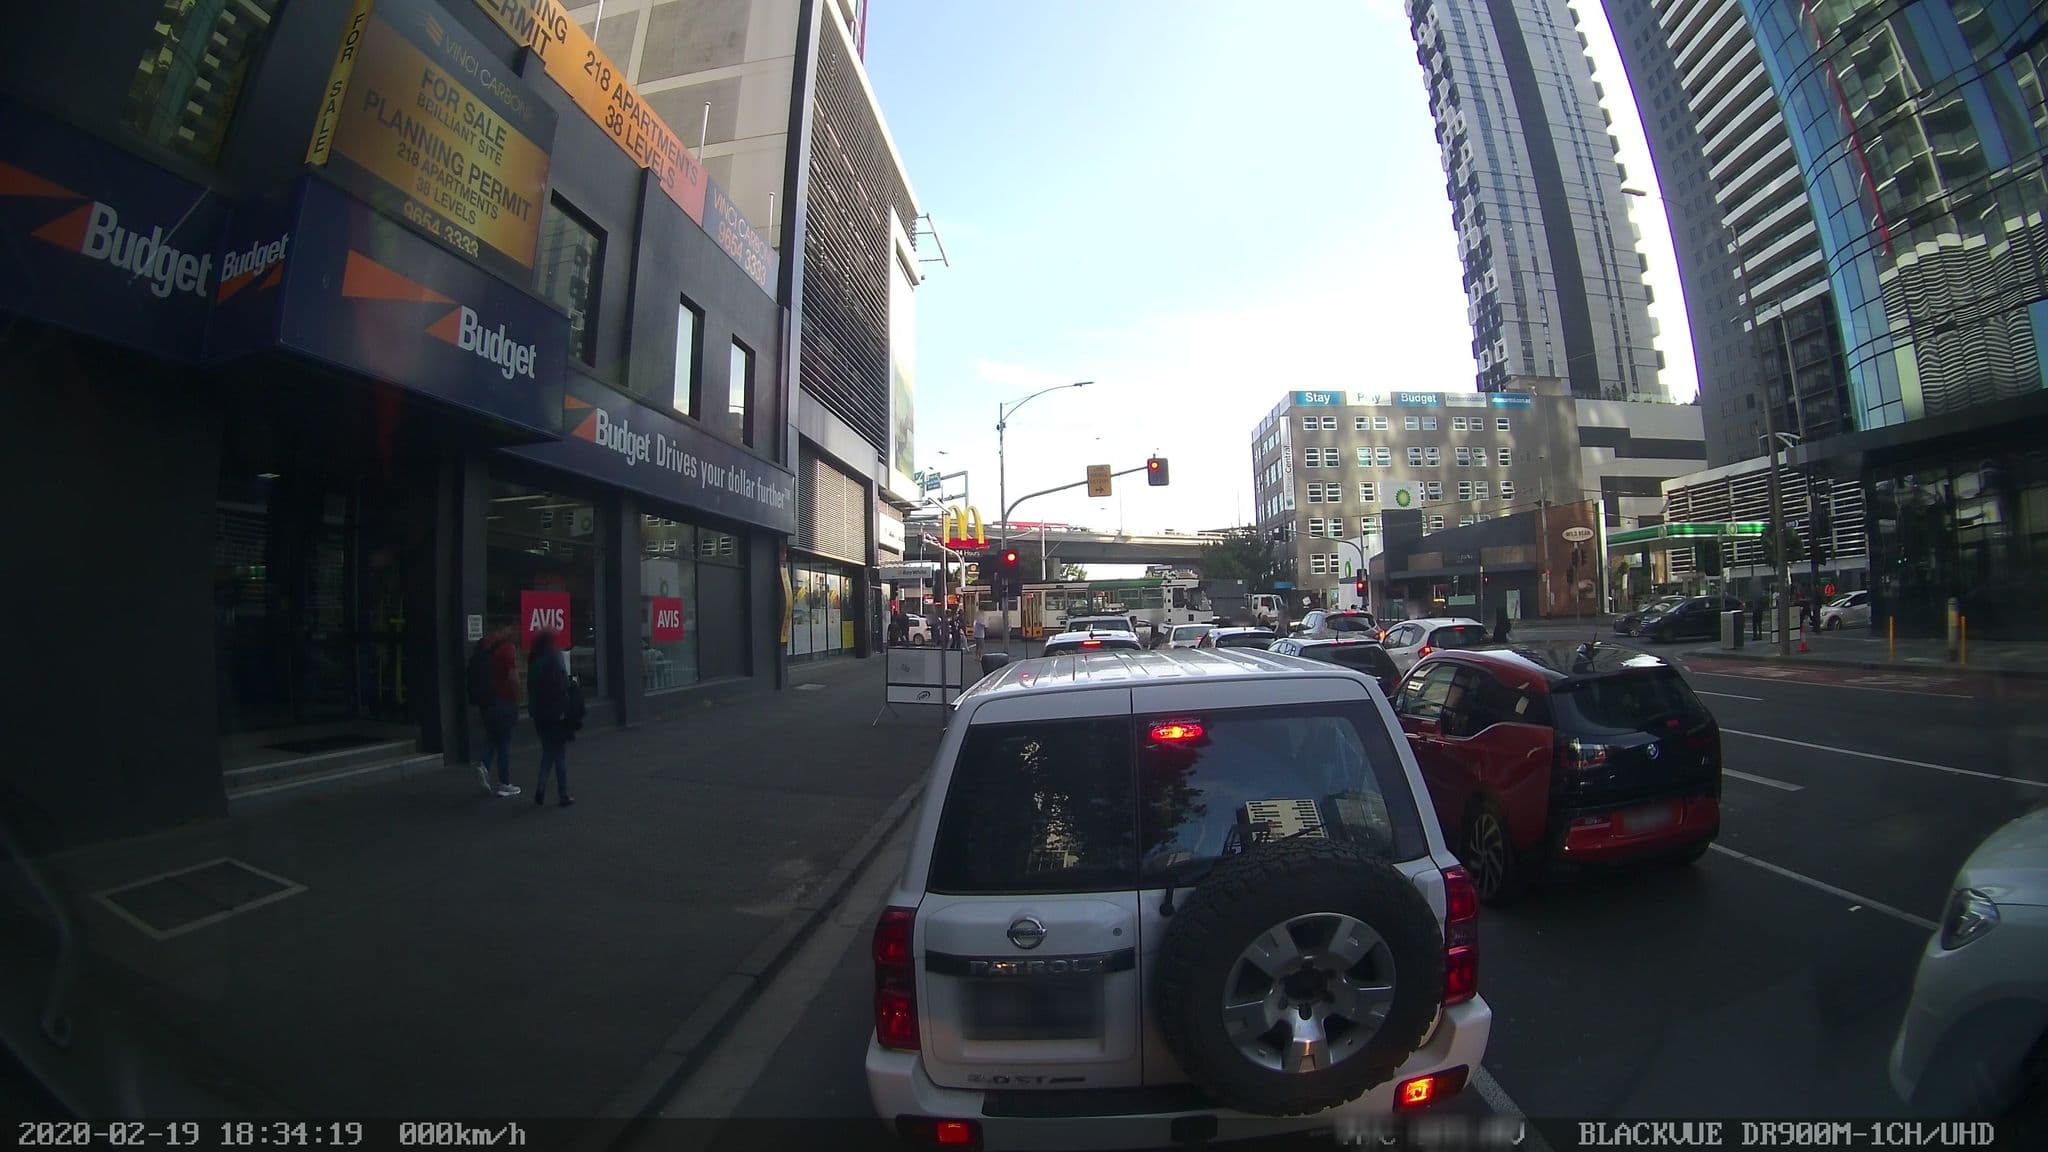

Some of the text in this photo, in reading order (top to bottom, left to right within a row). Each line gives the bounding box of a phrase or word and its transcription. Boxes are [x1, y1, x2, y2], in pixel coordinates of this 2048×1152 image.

[314, 13, 365, 153] FOR SALE
[445, 34, 480, 74] VINCI
[416, 92, 503, 166] BRILLIANT SITE
[421, 68, 507, 150] FOR SALE
[584, 50, 698, 187] 218 APARTMENTS
[605, 105, 676, 189] 38 LEVELS
[362, 87, 532, 222] PLANNING PERMIT
[398, 141, 498, 220] 218 APARTMENTS
[415, 176, 477, 226] 38 LEVELS
[81, 201, 212, 298] Budget
[221, 232, 288, 281] Budget
[457, 304, 537, 380] Budget
[1305, 392, 1331, 405] Stay
[1357, 392, 1381, 404] Py
[1401, 393, 1437, 404] Budget
[595, 408, 650, 466] Budget
[656, 433, 697, 478] Drives
[701, 460, 726, 489] your
[727, 465, 755, 499] dollar
[530, 608, 564, 632] AVIS
[657, 610, 680, 629] AVIS
